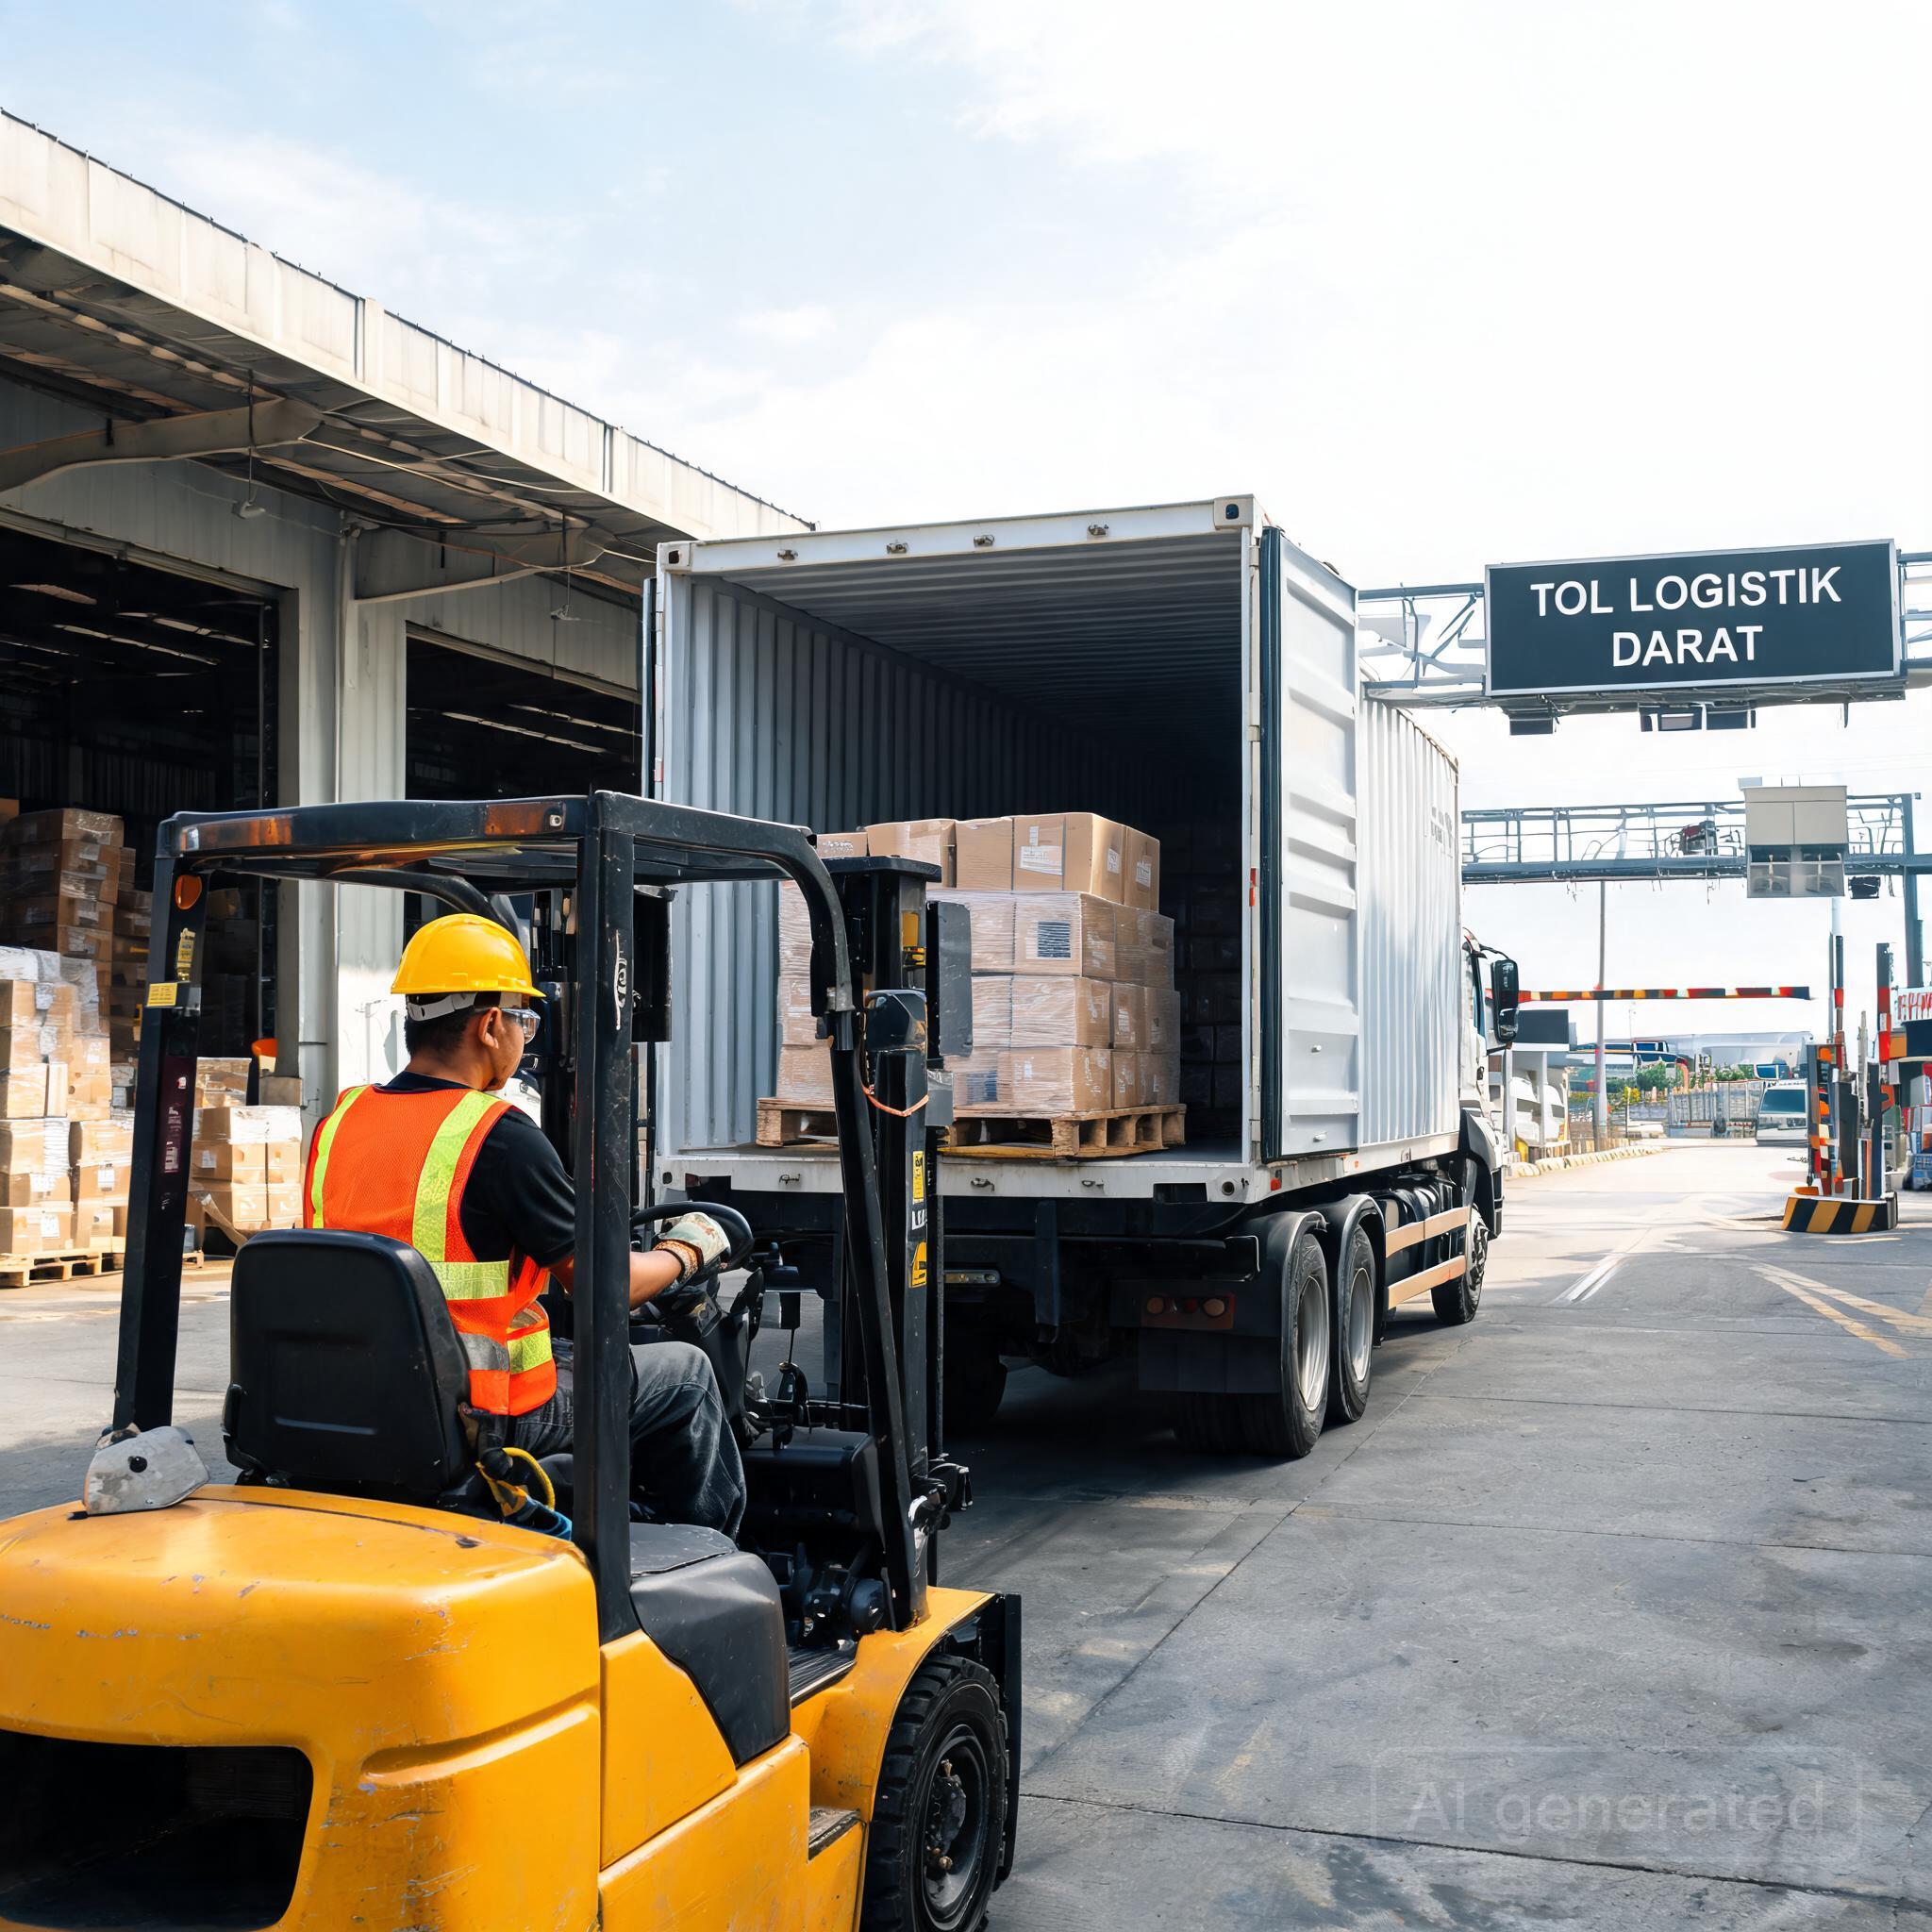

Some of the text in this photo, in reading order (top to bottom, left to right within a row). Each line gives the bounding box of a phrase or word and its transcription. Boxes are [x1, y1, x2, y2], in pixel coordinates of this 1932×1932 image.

[1529, 566, 1842, 617] TOL LOGISTIK
[1612, 625, 1764, 667] DARAT
